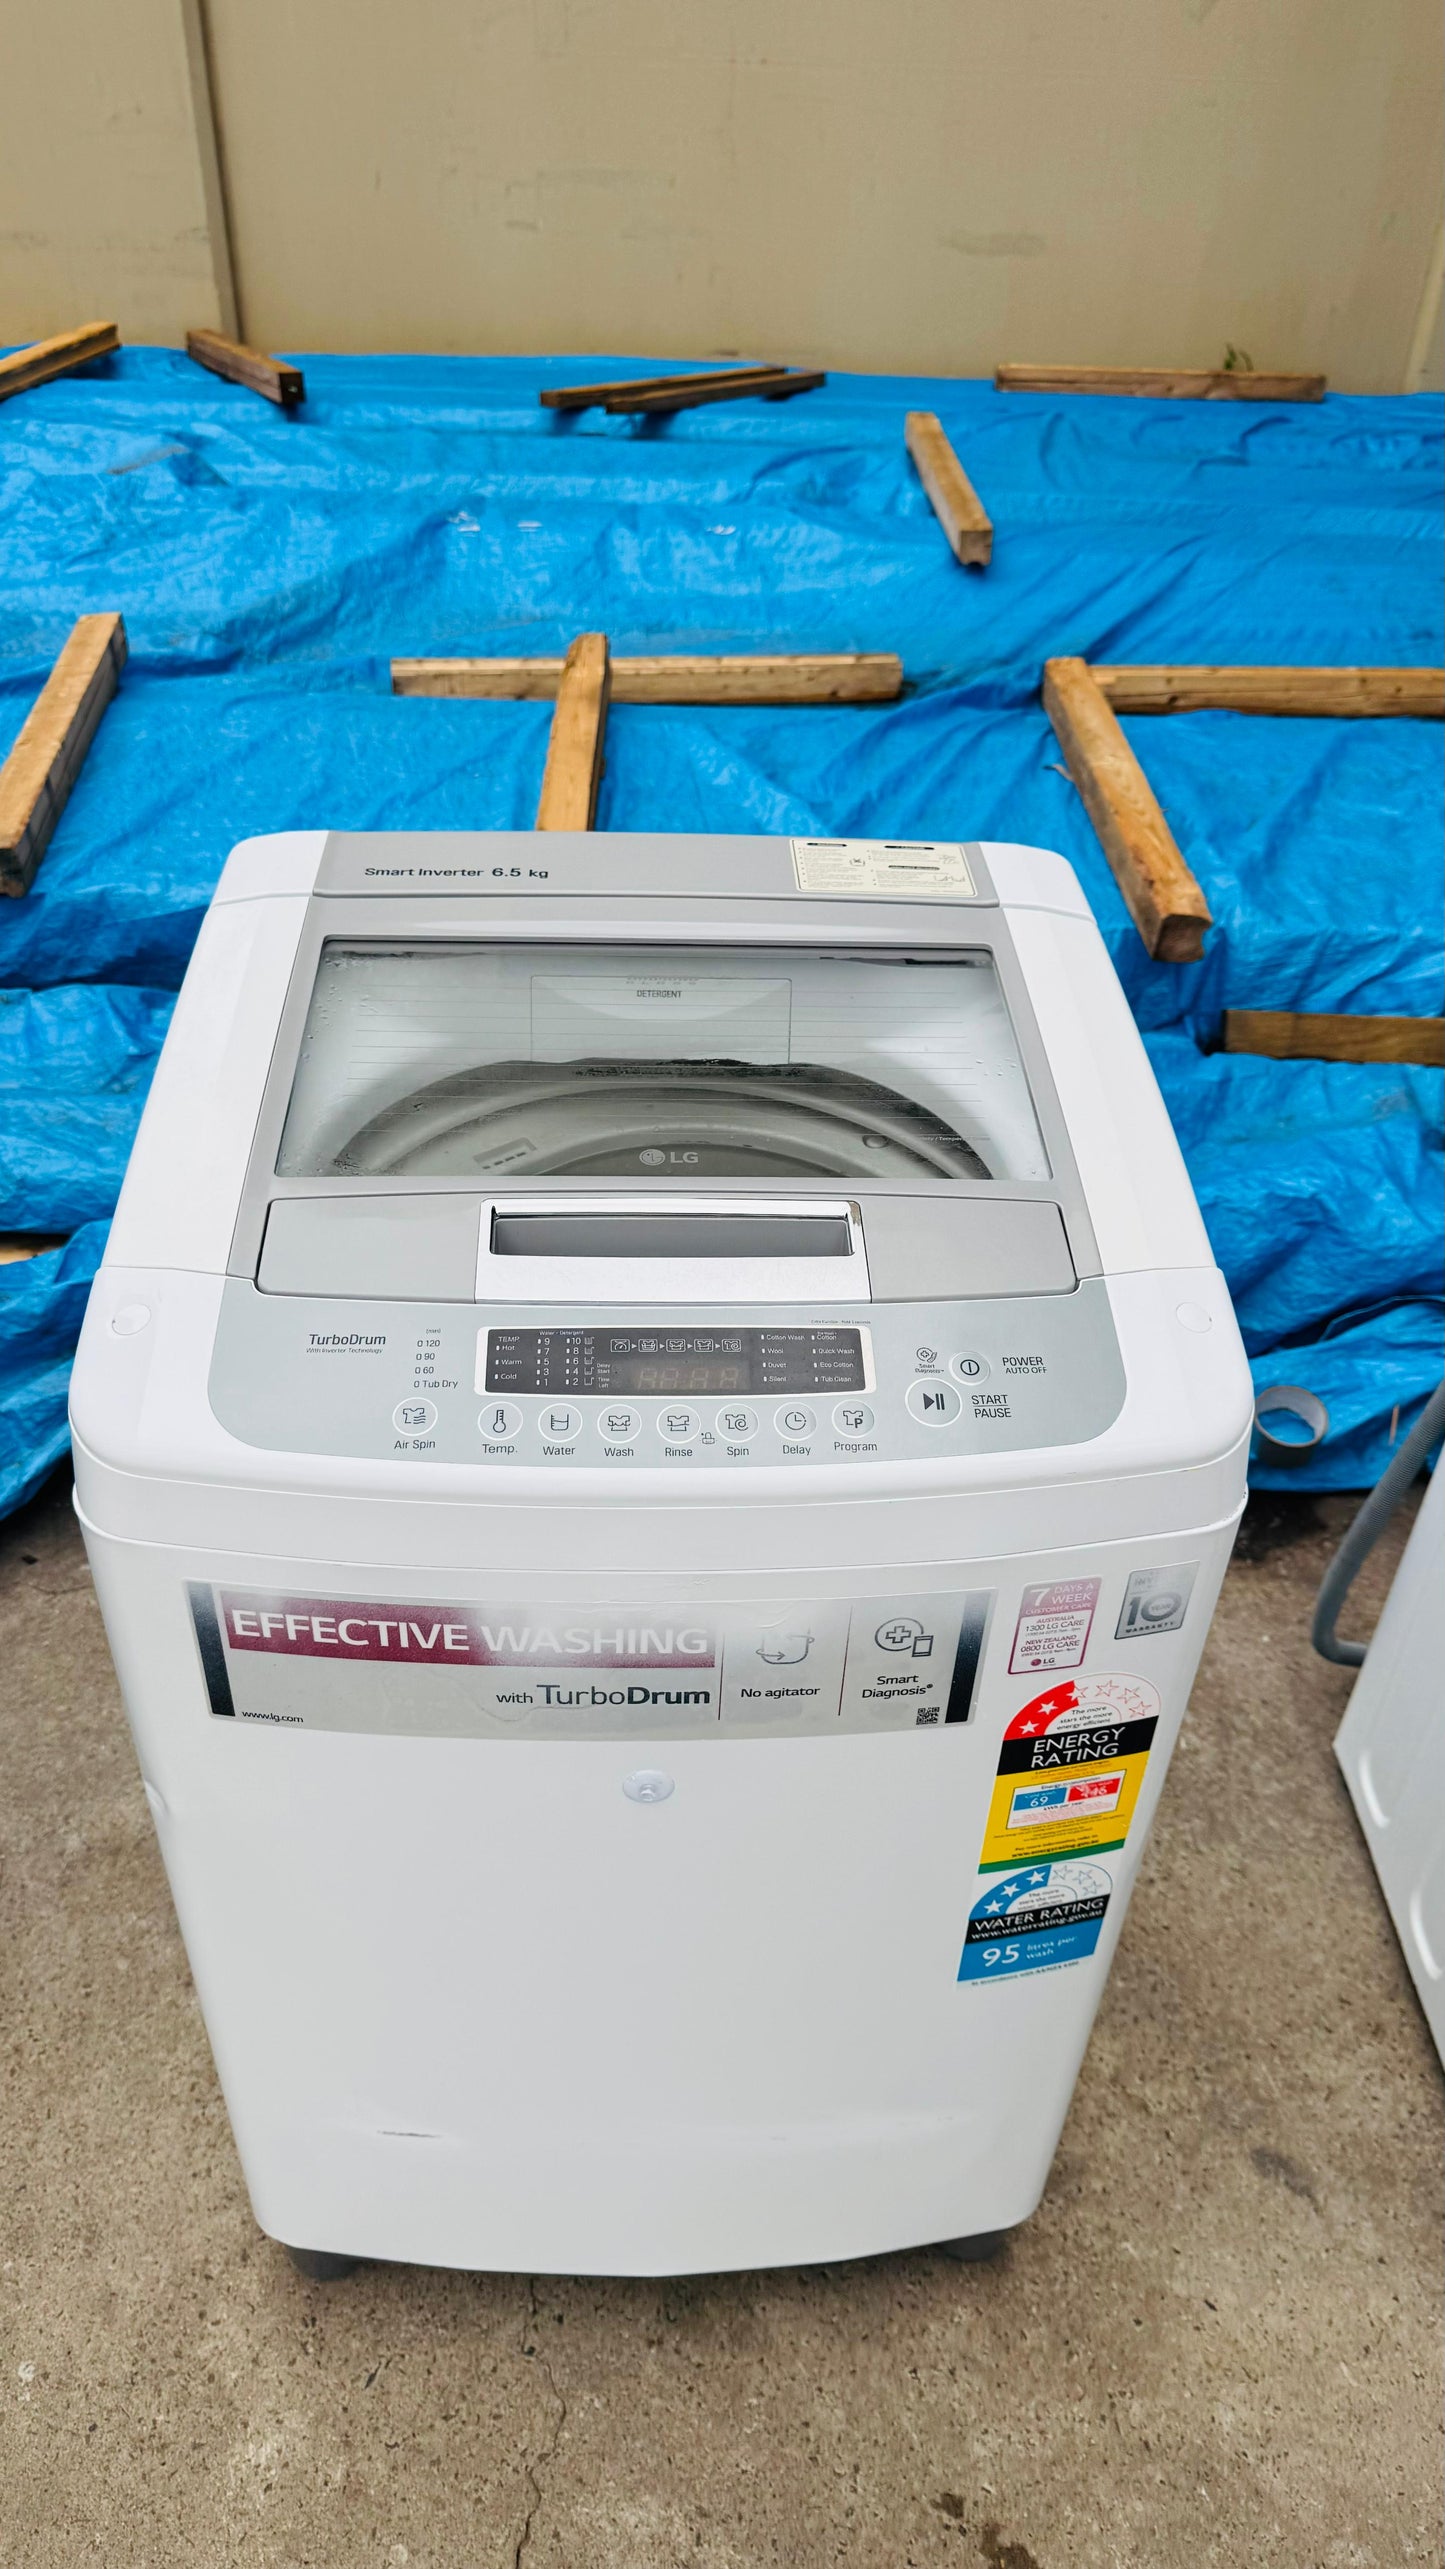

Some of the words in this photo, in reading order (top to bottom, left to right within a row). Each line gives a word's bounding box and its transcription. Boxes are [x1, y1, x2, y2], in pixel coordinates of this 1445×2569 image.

[365, 867, 415, 876] Smart
[418, 868, 484, 877] Inverter
[491, 867, 521, 877] 6.5
[528, 869, 549, 879] kg
[636, 990, 682, 998] DETERGENT
[670, 1152, 699, 1164] LG
[309, 1333, 386, 1345] TurboDrum
[426, 1340, 440, 1348] 120
[572, 1337, 581, 1345] 10
[348, 1347, 383, 1355] Technology
[424, 1352, 436, 1360] 90
[573, 1347, 579, 1355] 8
[544, 1358, 550, 1366] 5
[572, 1357, 579, 1365] 6
[1002, 1356, 1043, 1366] POWER
[422, 1366, 434, 1374] 60
[543, 1368, 550, 1376] 3
[1032, 1366, 1047, 1374] OFF
[422, 1380, 440, 1388] Tub
[442, 1380, 458, 1389] Dry
[544, 1378, 548, 1386] 1
[572, 1378, 578, 1386] 2
[971, 1394, 1008, 1405] START
[974, 1408, 1012, 1418] PAUSE
[394, 1440, 410, 1450] Air
[412, 1440, 436, 1451] Spin
[482, 1444, 518, 1456] Temp.
[542, 1446, 576, 1456] Water
[782, 1444, 811, 1456] Delay
[834, 1442, 878, 1453] Program
[604, 1447, 634, 1457] Wash
[664, 1447, 693, 1457] Rinse
[726, 1446, 750, 1458] Spin
[1030, 1588, 1050, 1606] 7
[1054, 1584, 1083, 1594] DAYS
[1086, 1582, 1094, 1590] A
[1051, 1592, 1093, 1604] WEEK
[1127, 1592, 1182, 1626] 10
[1036, 1615, 1074, 1624] AUSTRALIA
[1026, 1624, 1046, 1632] 1300
[1046, 1622, 1059, 1630] LG
[1060, 1619, 1085, 1628] CARE
[231, 1609, 470, 1652] EFFECTIVE
[481, 1625, 708, 1655] WASHING
[1044, 1634, 1077, 1643] ZEALAND
[1020, 1644, 1041, 1653] 0800
[1056, 1640, 1080, 1648] CARE
[877, 1675, 918, 1686] Smart
[495, 1690, 534, 1704] with
[536, 1684, 711, 1705] TurboDrum
[741, 1688, 762, 1698] No
[764, 1686, 820, 1700] agitator
[1087, 1706, 1108, 1714] more
[241, 1710, 304, 1724] www.lg.com
[1034, 1726, 1126, 1754] ENERGY
[1030, 1743, 1120, 1768] RATING
[1030, 1796, 1049, 1808] 69
[975, 1912, 1034, 1932] WATER
[1040, 1898, 1104, 1920] RATING
[971, 1910, 1103, 1940] www.waterrating.gov.au
[982, 1944, 1020, 1968] 95
